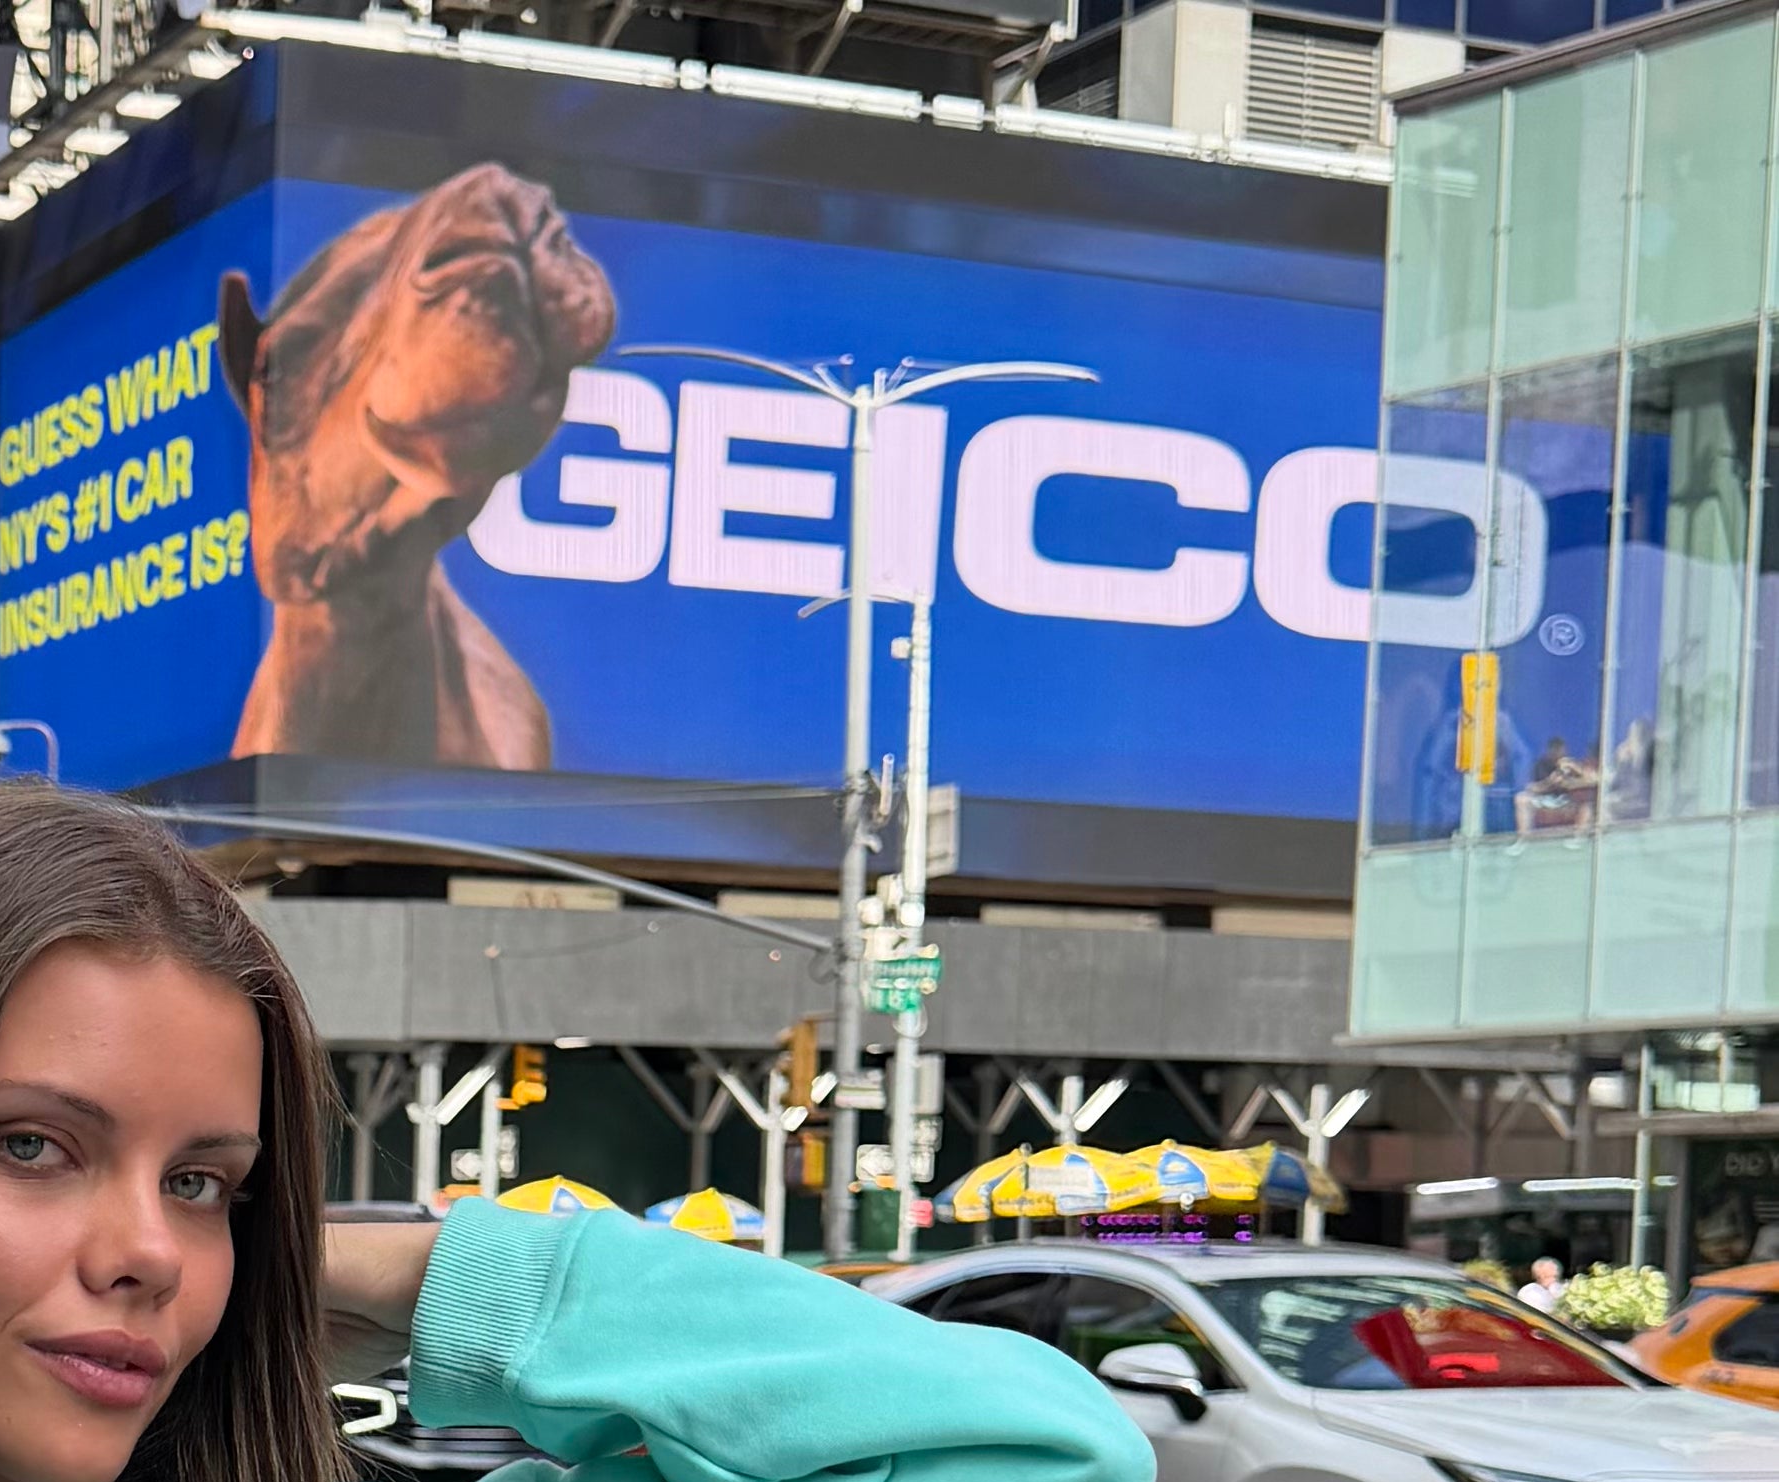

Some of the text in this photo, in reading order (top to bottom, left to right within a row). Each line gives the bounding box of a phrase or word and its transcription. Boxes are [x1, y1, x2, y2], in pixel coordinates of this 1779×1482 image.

[106, 322, 220, 435] WHAT
[72, 471, 113, 543] #1
[116, 435, 194, 523] CAR
[467, 365, 1549, 652] GEICO
[189, 508, 251, 590] IS?
